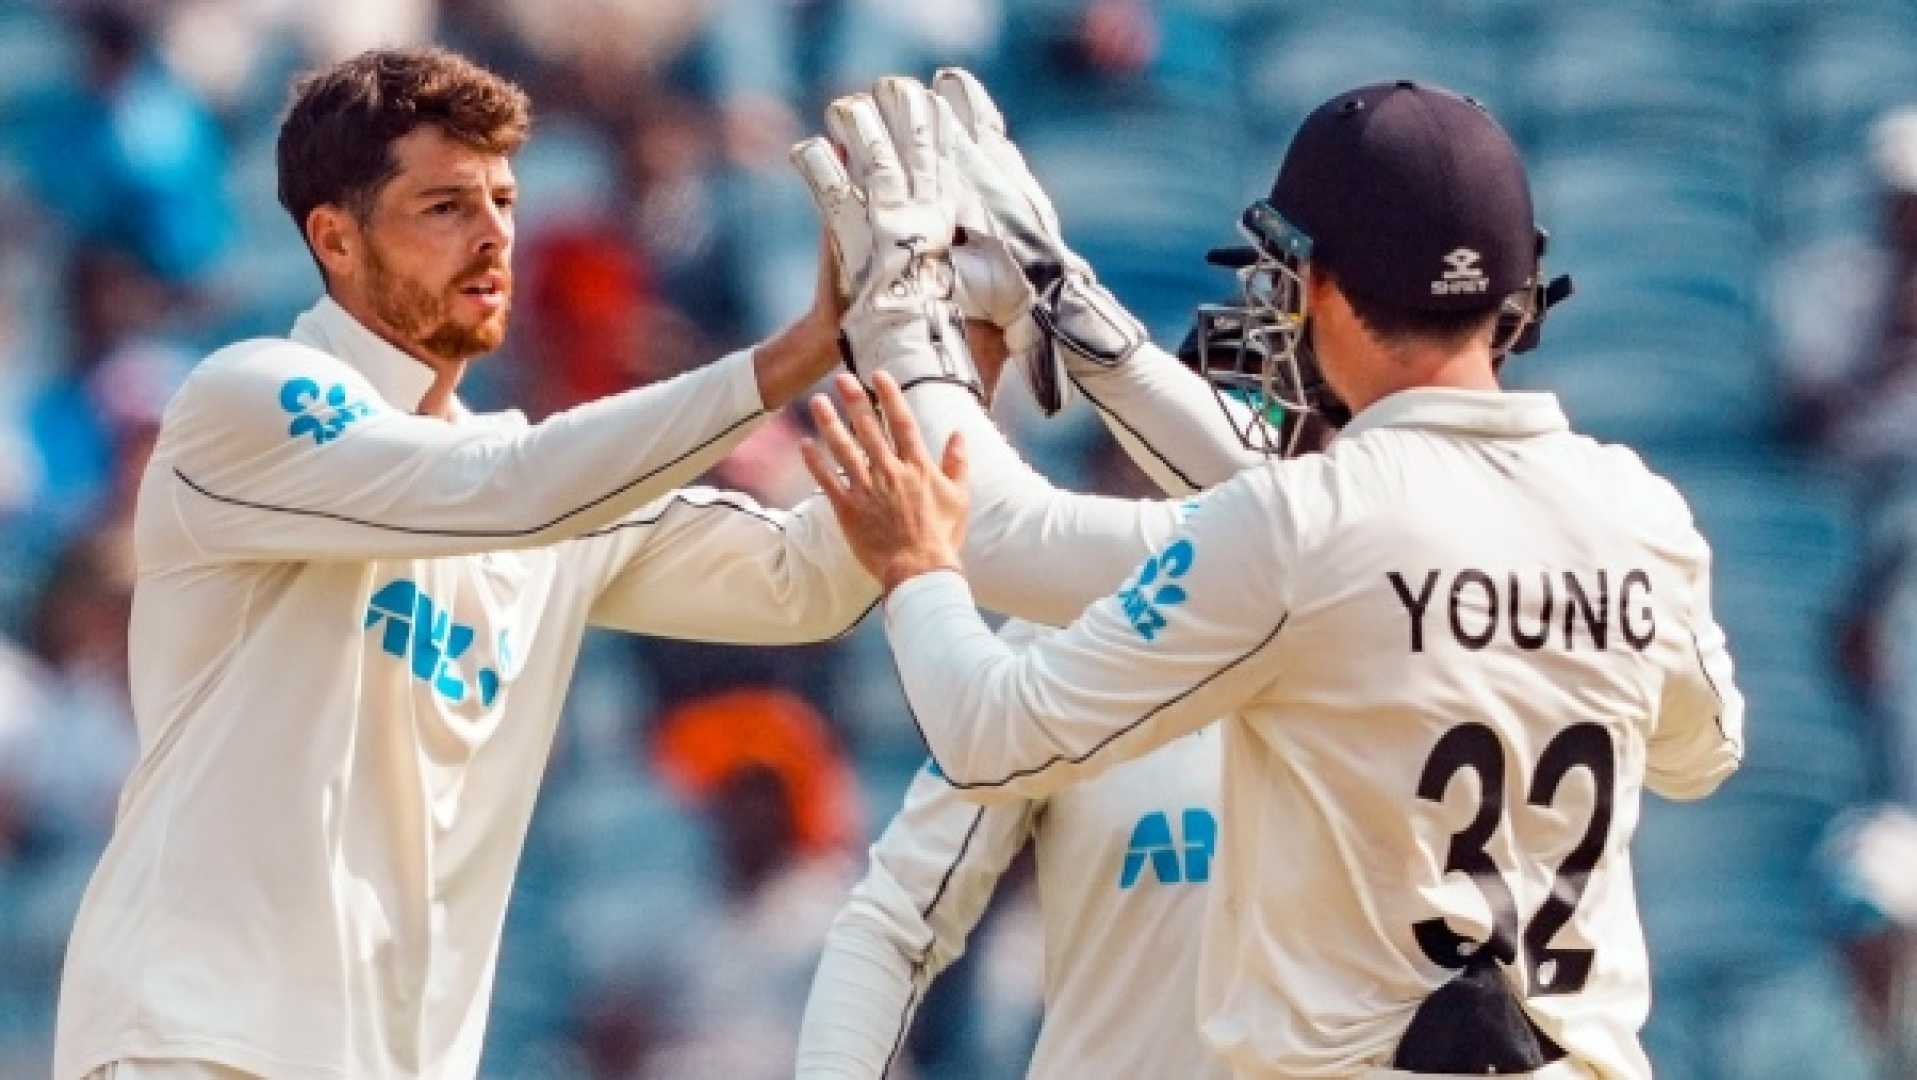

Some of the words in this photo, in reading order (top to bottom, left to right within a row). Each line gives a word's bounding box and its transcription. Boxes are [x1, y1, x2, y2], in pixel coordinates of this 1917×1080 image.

[1386, 568, 1656, 652] YOUNG
[1120, 809, 1216, 889] AN
[1411, 721, 1614, 996] 32
